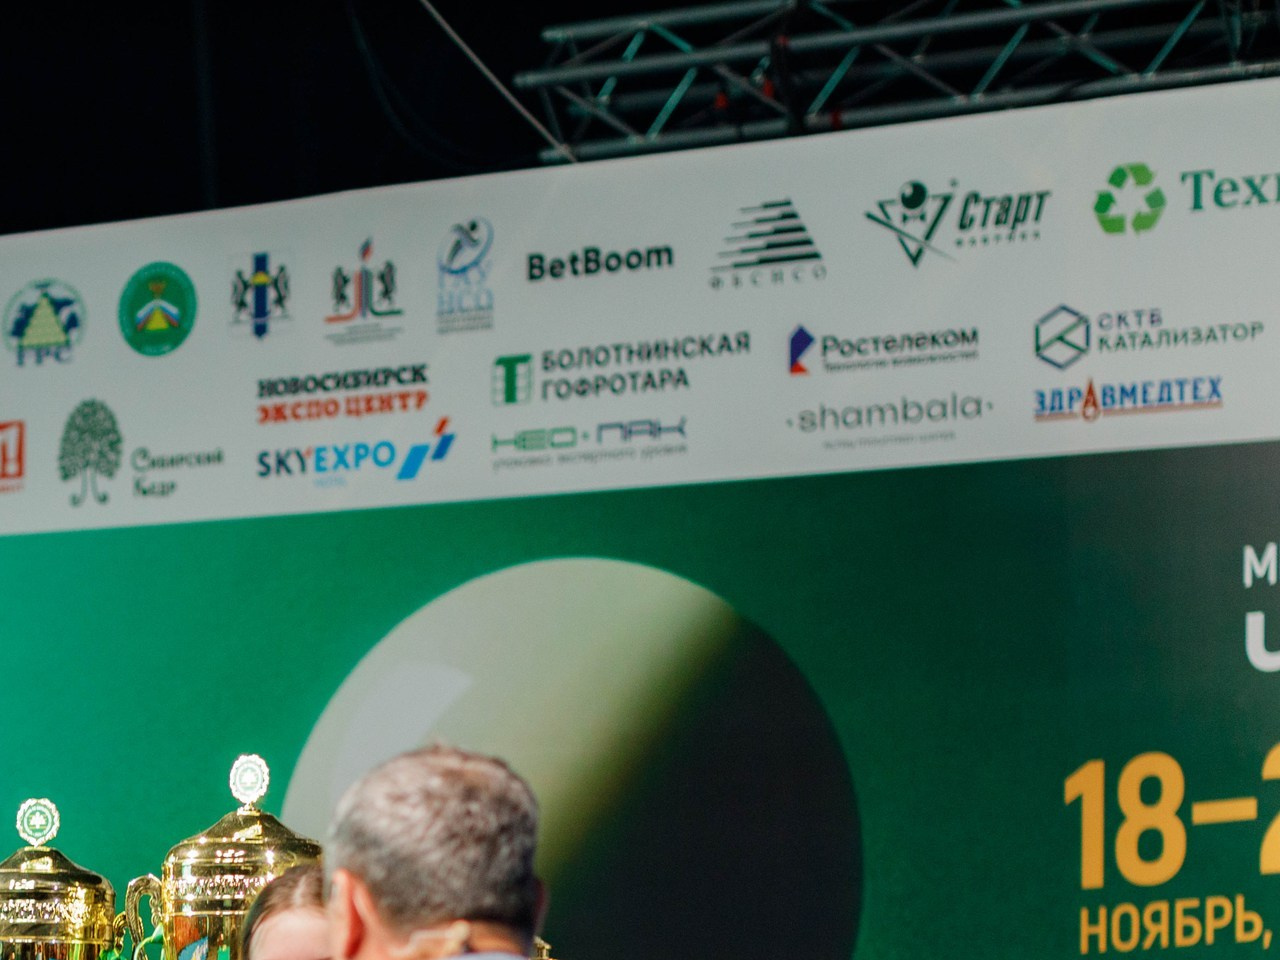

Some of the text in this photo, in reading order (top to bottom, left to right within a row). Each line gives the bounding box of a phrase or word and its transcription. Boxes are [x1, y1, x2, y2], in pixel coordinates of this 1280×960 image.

[1180, 168, 1280, 211] Тех
[958, 189, 1052, 236] Старт
[527, 244, 675, 281] BetBoom
[540, 331, 751, 372] БОЛОТНИНСКАЯ
[821, 326, 980, 358] Ростелеком
[1097, 321, 1265, 352] КАТАЛИЗАТОР
[257, 363, 429, 398] НОВОСИБИРСК
[540, 366, 690, 400] ГОФРОТАРА
[257, 390, 429, 424] ЭКСПО ЦЕНТР
[257, 440, 396, 478] SKYEXPO
[1079, 893, 1273, 955] НОЯБРЬ,
